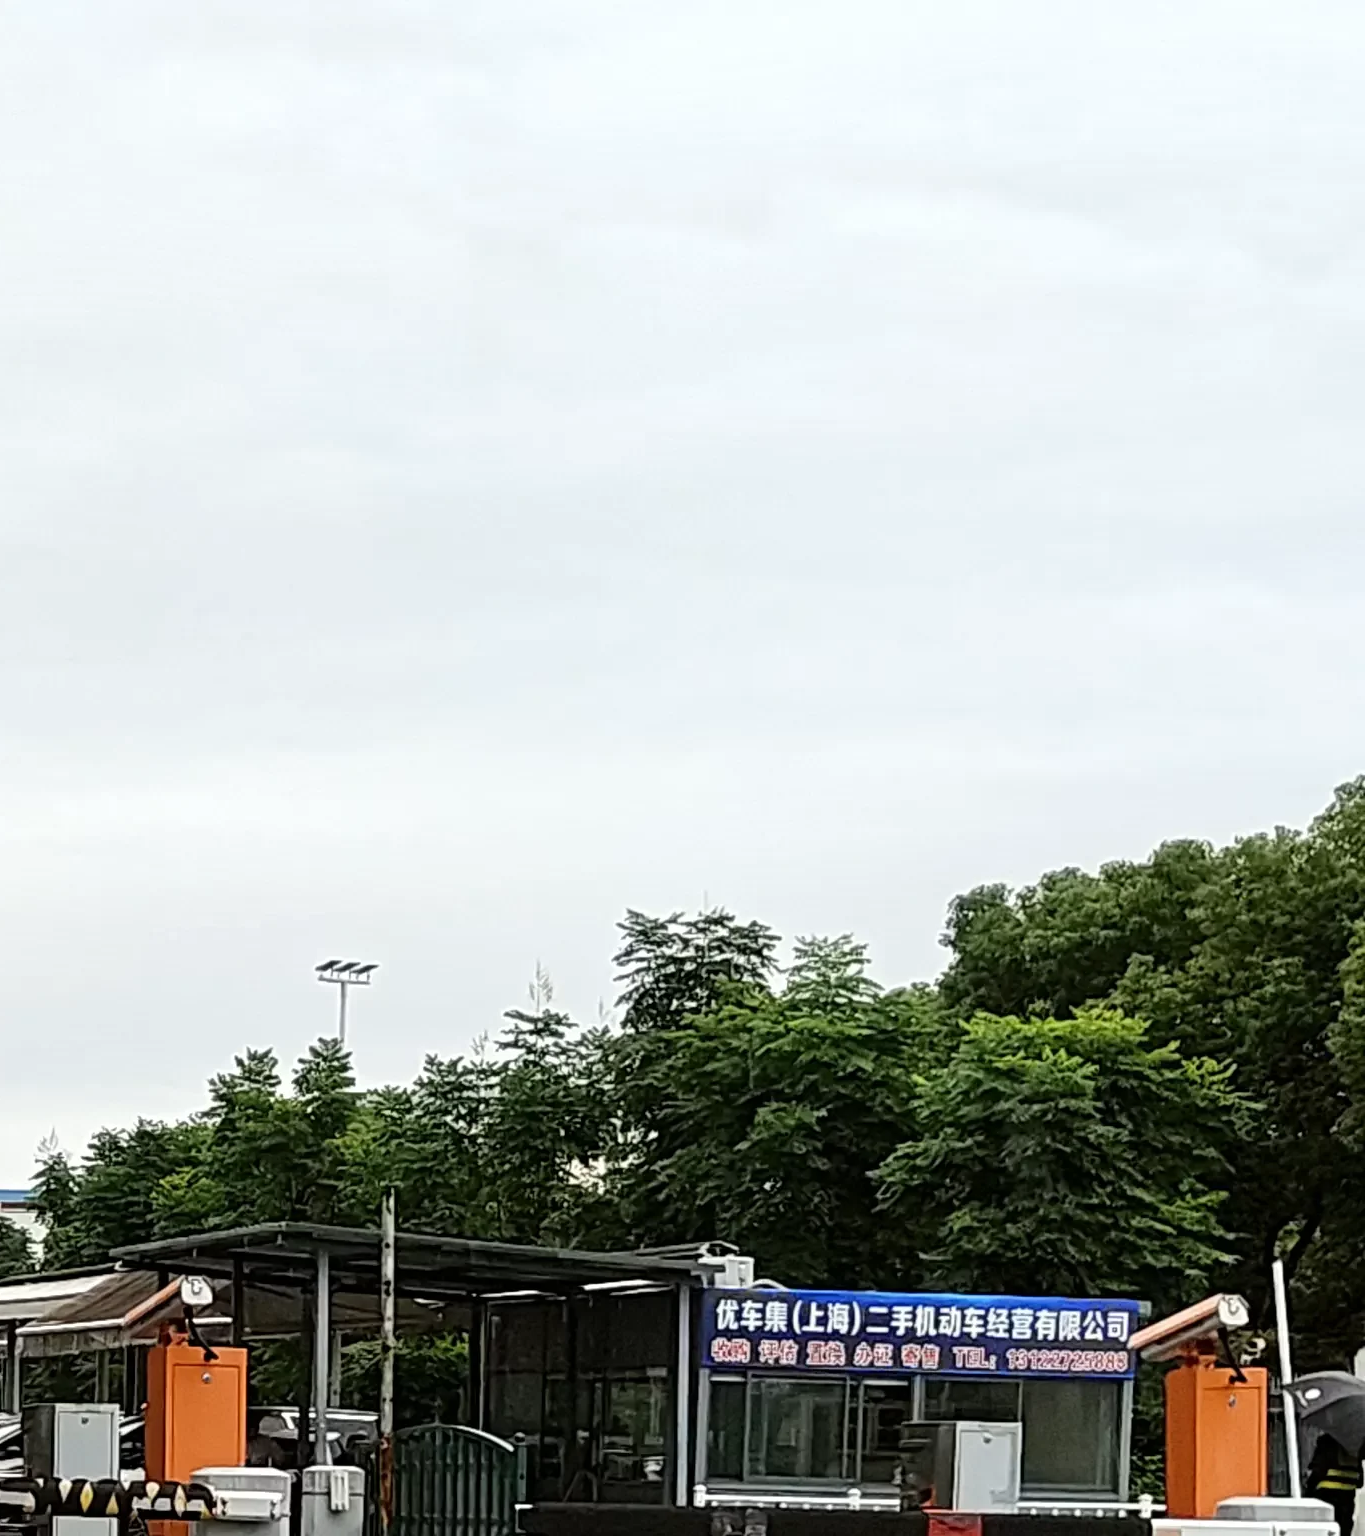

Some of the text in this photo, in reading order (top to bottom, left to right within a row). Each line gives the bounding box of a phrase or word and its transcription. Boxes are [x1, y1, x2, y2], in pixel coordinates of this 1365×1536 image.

[759, 1339, 799, 1365] 评估
[806, 1341, 846, 1366] 置换
[853, 1342, 894, 1367] 办证
